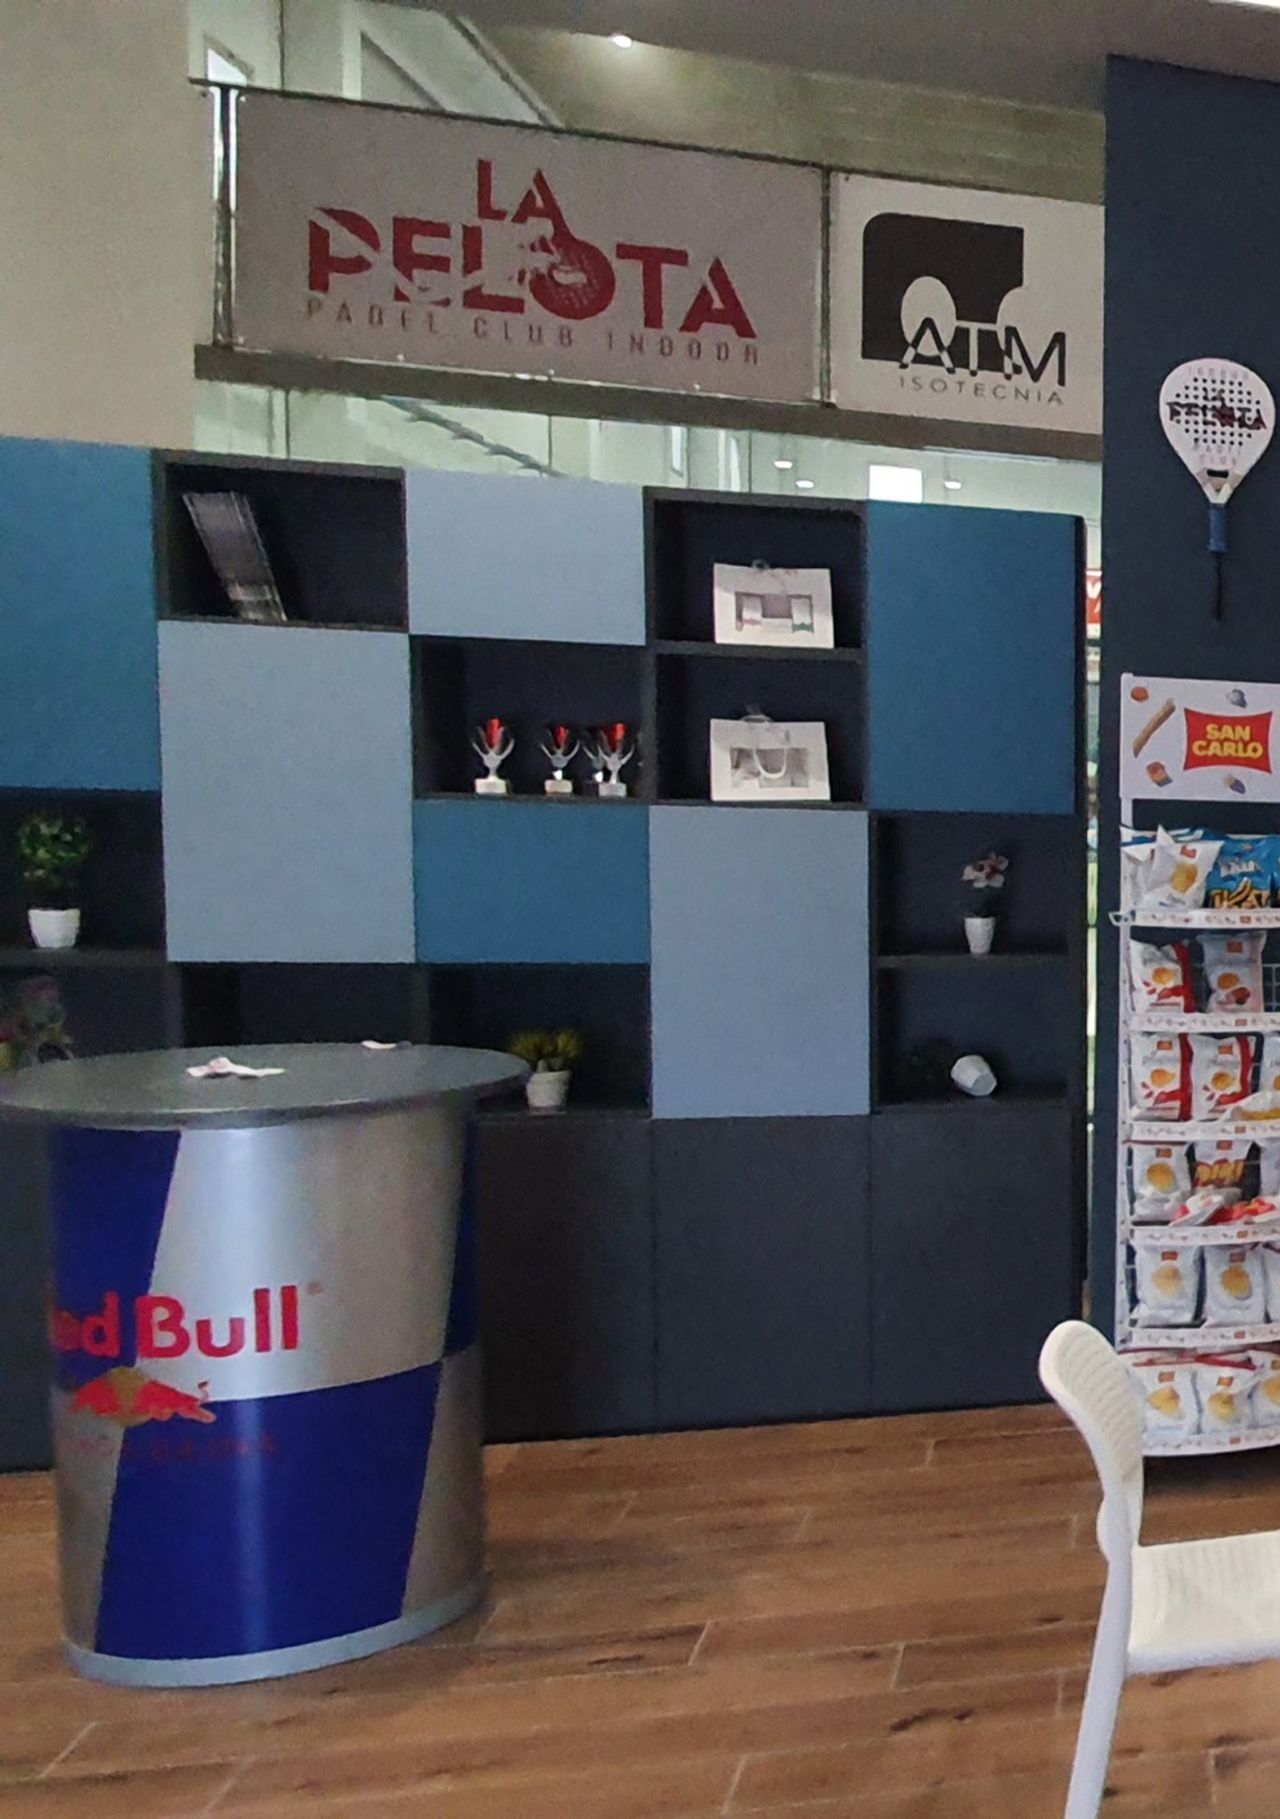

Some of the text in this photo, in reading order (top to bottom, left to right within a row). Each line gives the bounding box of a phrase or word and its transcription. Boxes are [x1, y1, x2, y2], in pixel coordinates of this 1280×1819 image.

[476, 158, 565, 224] LA
[308, 206, 758, 339] PELOTA
[306, 299, 760, 365] PADEL CLUB INDOOR
[899, 317, 1067, 388] ATM
[899, 375, 1065, 405] ISOTECNIA
[1191, 740, 1264, 759] CARLO
[1205, 723, 1251, 741] SAN
[50, 1284, 299, 1359] ed Bull
